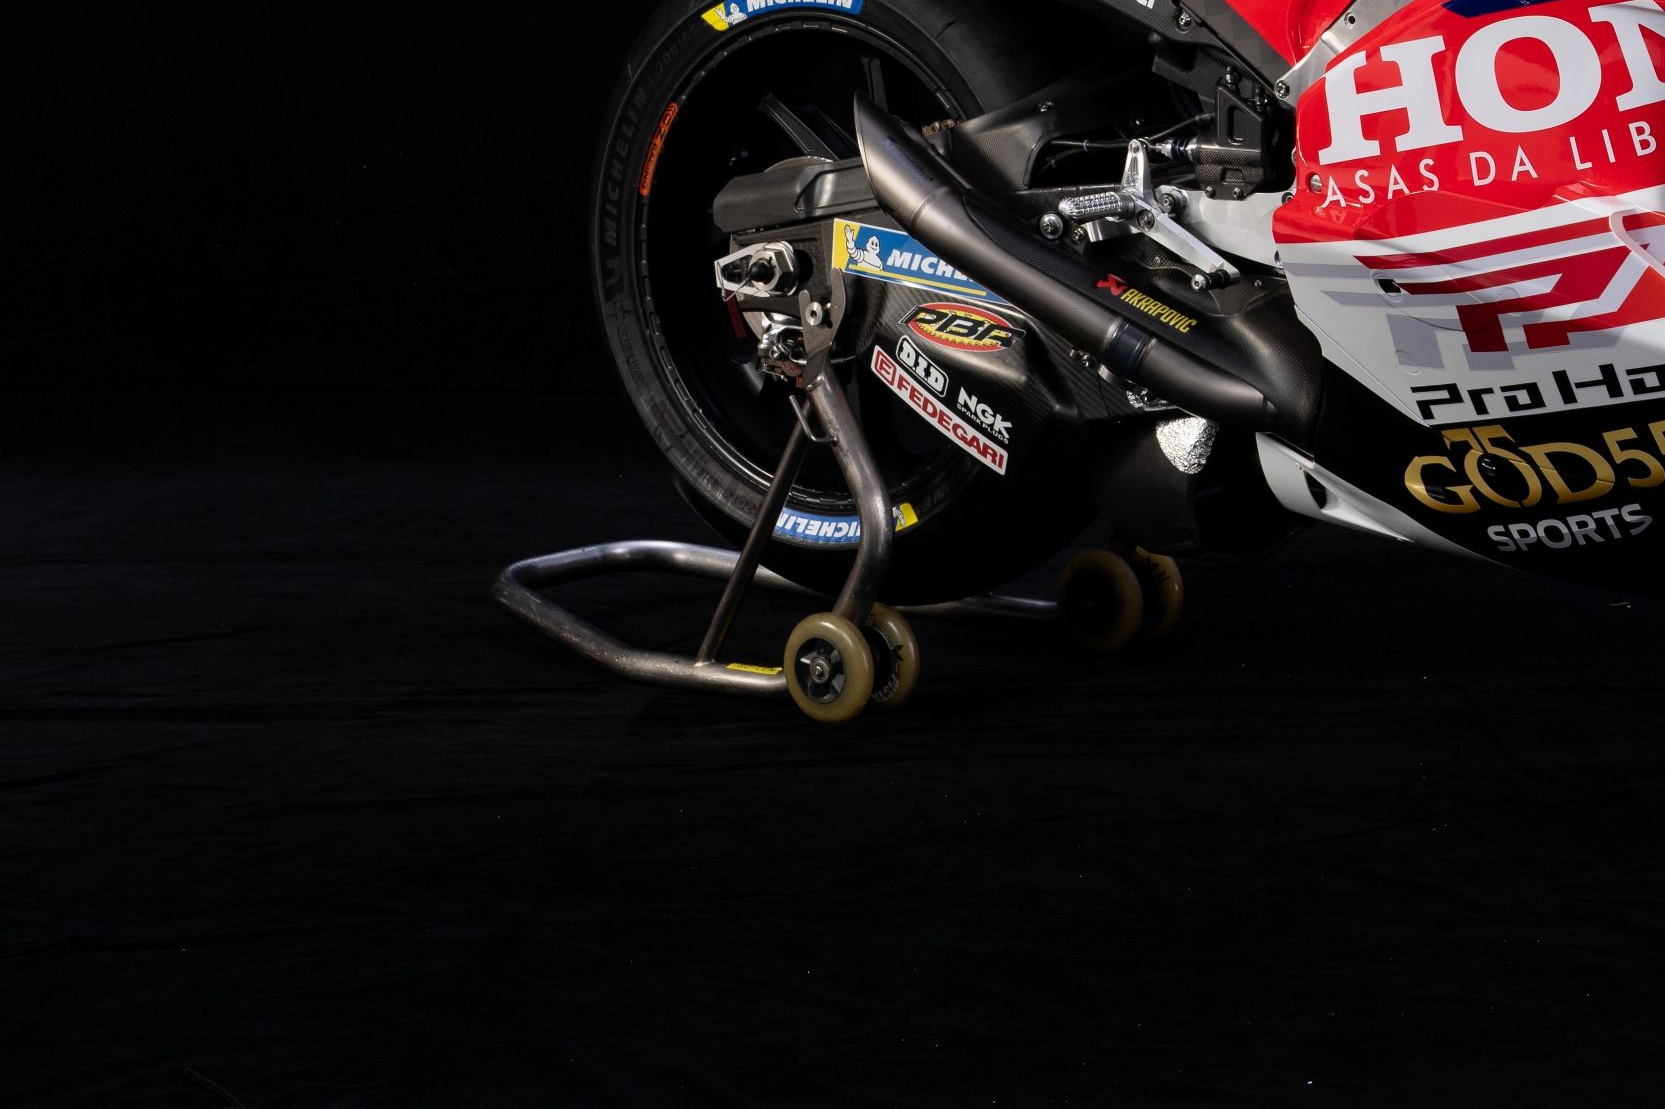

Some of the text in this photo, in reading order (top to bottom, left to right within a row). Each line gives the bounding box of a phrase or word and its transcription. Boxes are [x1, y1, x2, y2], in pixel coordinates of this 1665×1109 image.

[1321, 156, 1440, 209] ASAS
[1470, 145, 1539, 188] DA
[897, 374, 1005, 470] FEDEGARI
[956, 403, 1010, 444] SPARK PLUGS
[957, 386, 1013, 438] NGK
[1411, 381, 1545, 420] Pro
[1487, 503, 1653, 552] SPORTS
